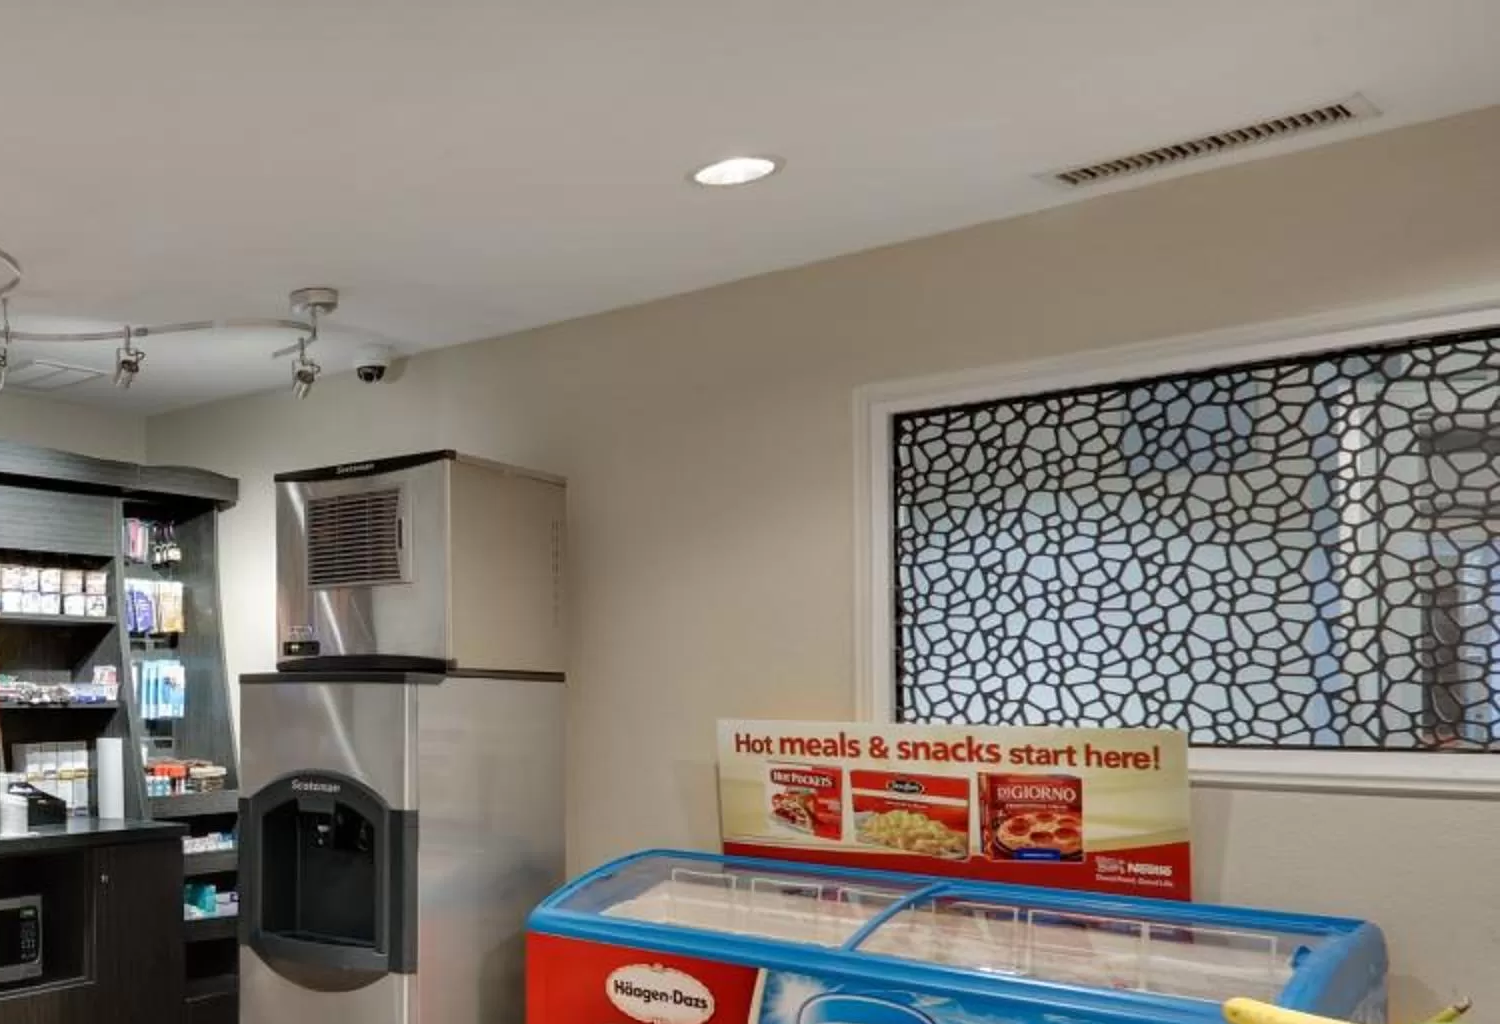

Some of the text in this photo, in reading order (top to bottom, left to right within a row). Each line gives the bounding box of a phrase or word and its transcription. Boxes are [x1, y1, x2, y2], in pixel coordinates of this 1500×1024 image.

[734, 732, 1161, 770] Hot meals & snacks start here!
[613, 979, 708, 1010] Häagen-Dazs
